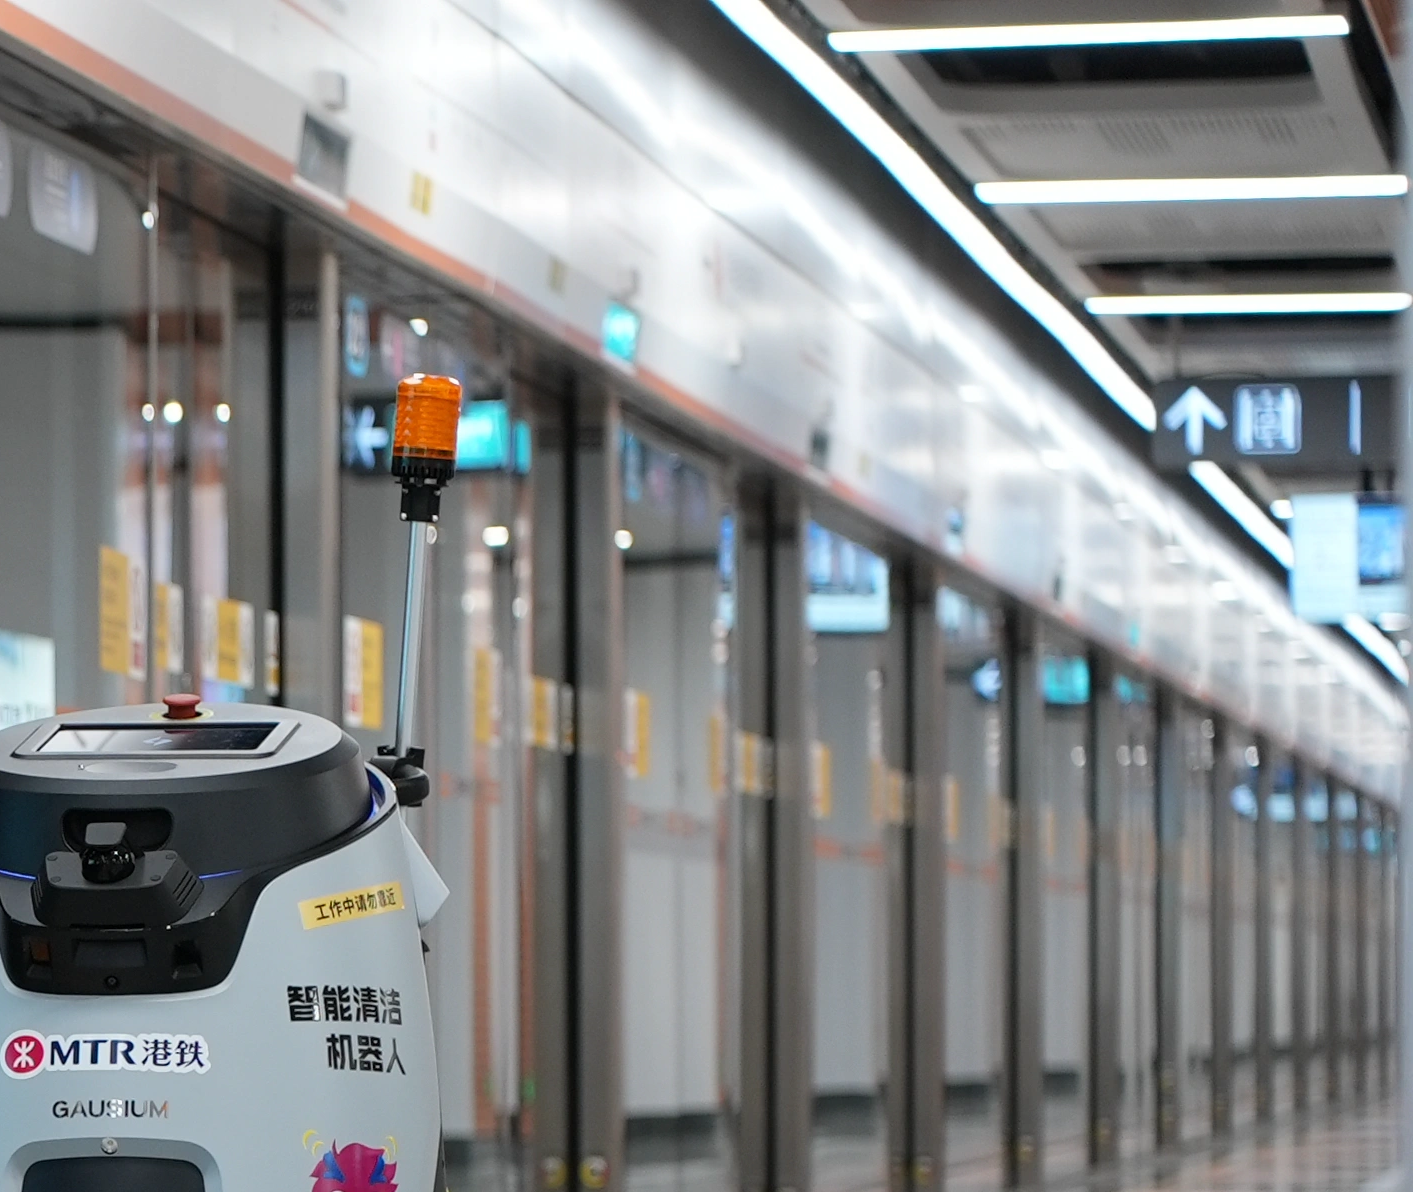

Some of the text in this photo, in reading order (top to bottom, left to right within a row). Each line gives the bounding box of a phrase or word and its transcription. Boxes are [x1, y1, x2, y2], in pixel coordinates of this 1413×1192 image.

[314, 887, 397, 922] 工作中请勿靠近
[287, 984, 403, 1026] 智能清洁
[50, 1039, 205, 1068] MTR 港铁
[325, 1033, 406, 1076] 机器人
[52, 1099, 169, 1119] GAUSIUM
